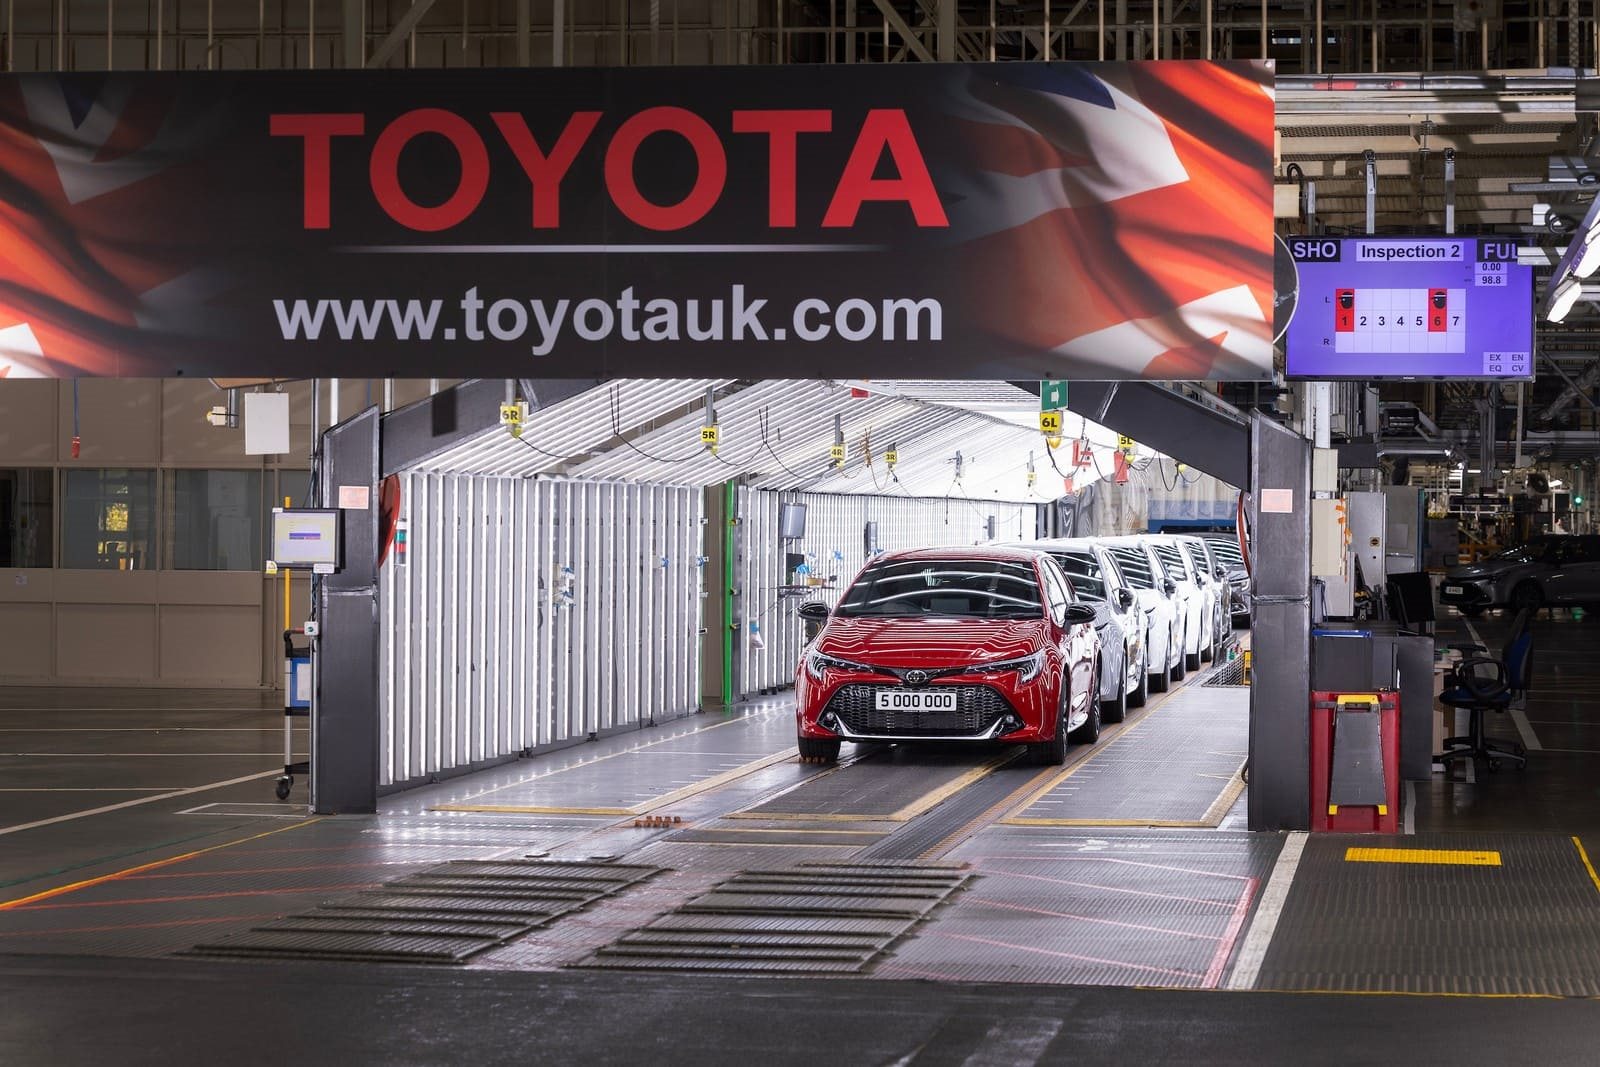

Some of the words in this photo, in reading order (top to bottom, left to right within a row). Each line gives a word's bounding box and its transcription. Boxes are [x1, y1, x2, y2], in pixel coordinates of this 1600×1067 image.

[269, 105, 950, 232] TOYOTA
[1293, 241, 1337, 258] SHO
[1362, 244, 1446, 260] Inspection
[1451, 244, 1460, 258] 2
[1482, 262, 1501, 271] 0.00
[1482, 275, 1501, 284] 98.8
[1325, 296, 1331, 304] L
[273, 284, 942, 356] www.toyotauk.com
[1342, 316, 1348, 326] 1
[1360, 316, 1367, 326] 2
[1378, 316, 1385, 326] 3
[1397, 316, 1404, 326] 4
[1415, 316, 1423, 326] 5
[1434, 316, 1441, 326] 6
[1452, 316, 1460, 326] 7
[1489, 353, 1501, 361] EX
[1511, 353, 1524, 361] EN
[1511, 364, 1524, 372] CV
[502, 410, 518, 420] 6R
[1042, 417, 1058, 428] 6L
[702, 430, 715, 439] 5R
[1120, 436, 1132, 445] 5L
[831, 448, 842, 456] 4R
[881, 694, 889, 707] 5
[893, 694, 920, 707] 000
[924, 694, 952, 708] 000
